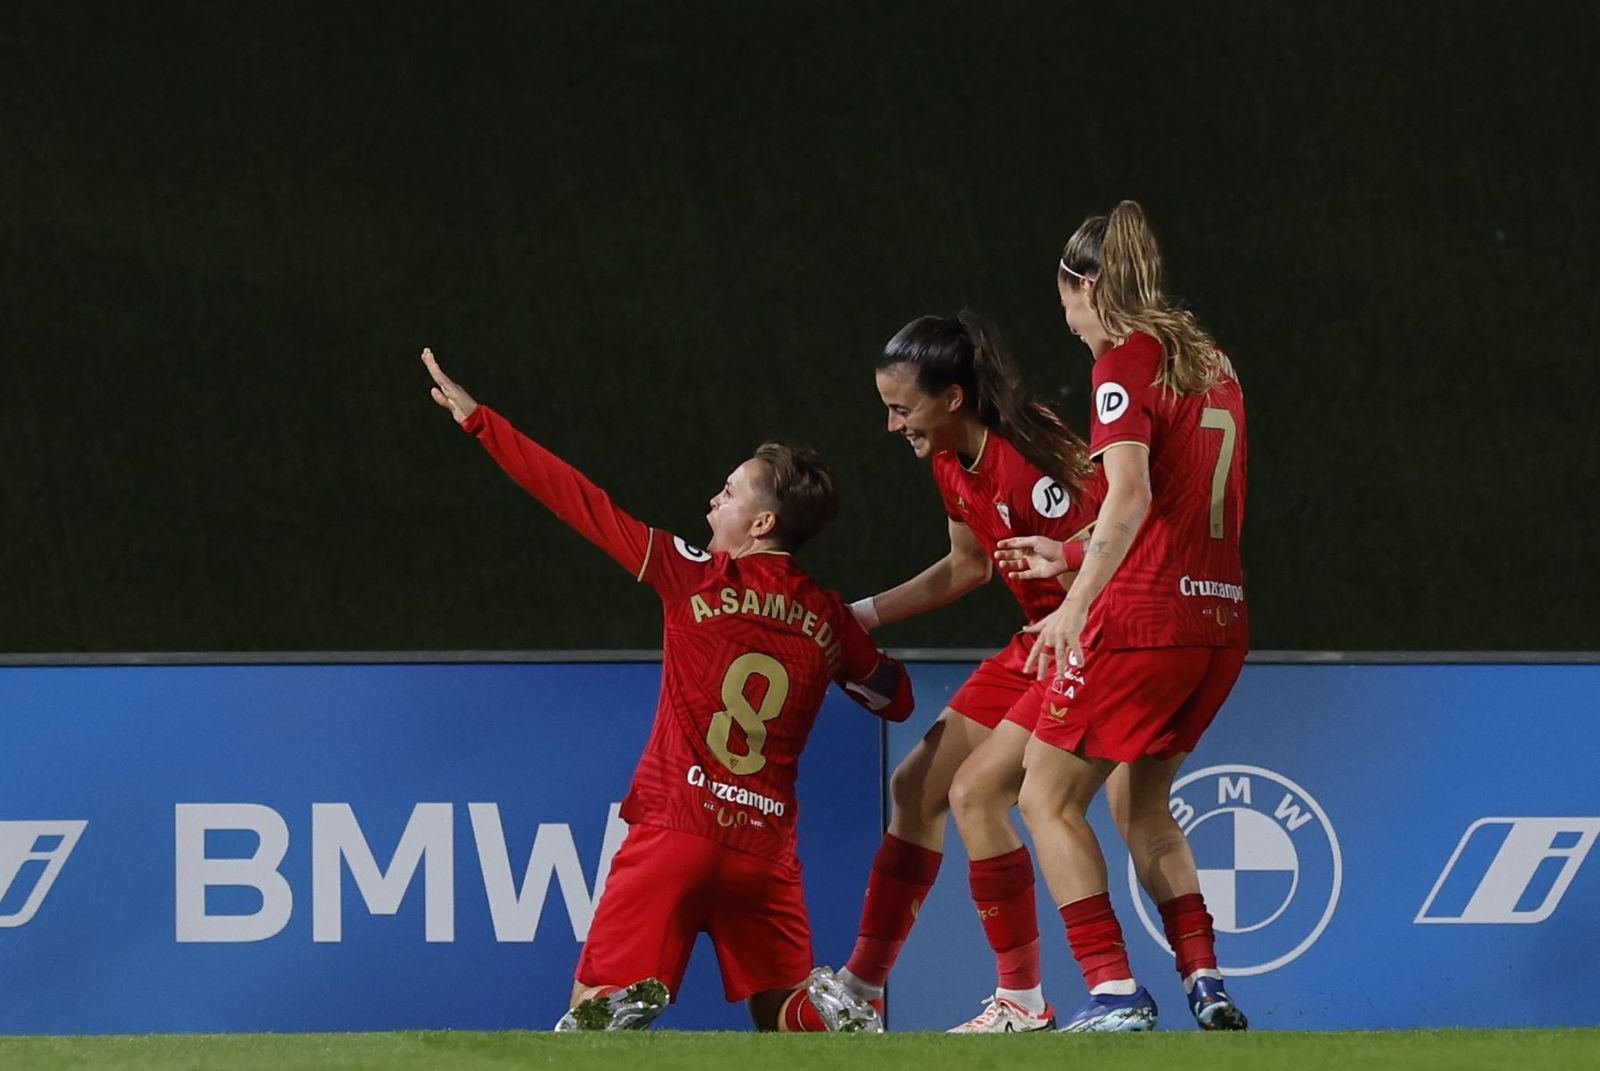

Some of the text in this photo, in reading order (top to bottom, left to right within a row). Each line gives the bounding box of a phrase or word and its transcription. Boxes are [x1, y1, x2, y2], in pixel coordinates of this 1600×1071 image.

[1043, 482, 1064, 513] JD
[1200, 407, 1236, 539] 7
[706, 652, 789, 775] 8
[175, 803, 628, 943] BMW
